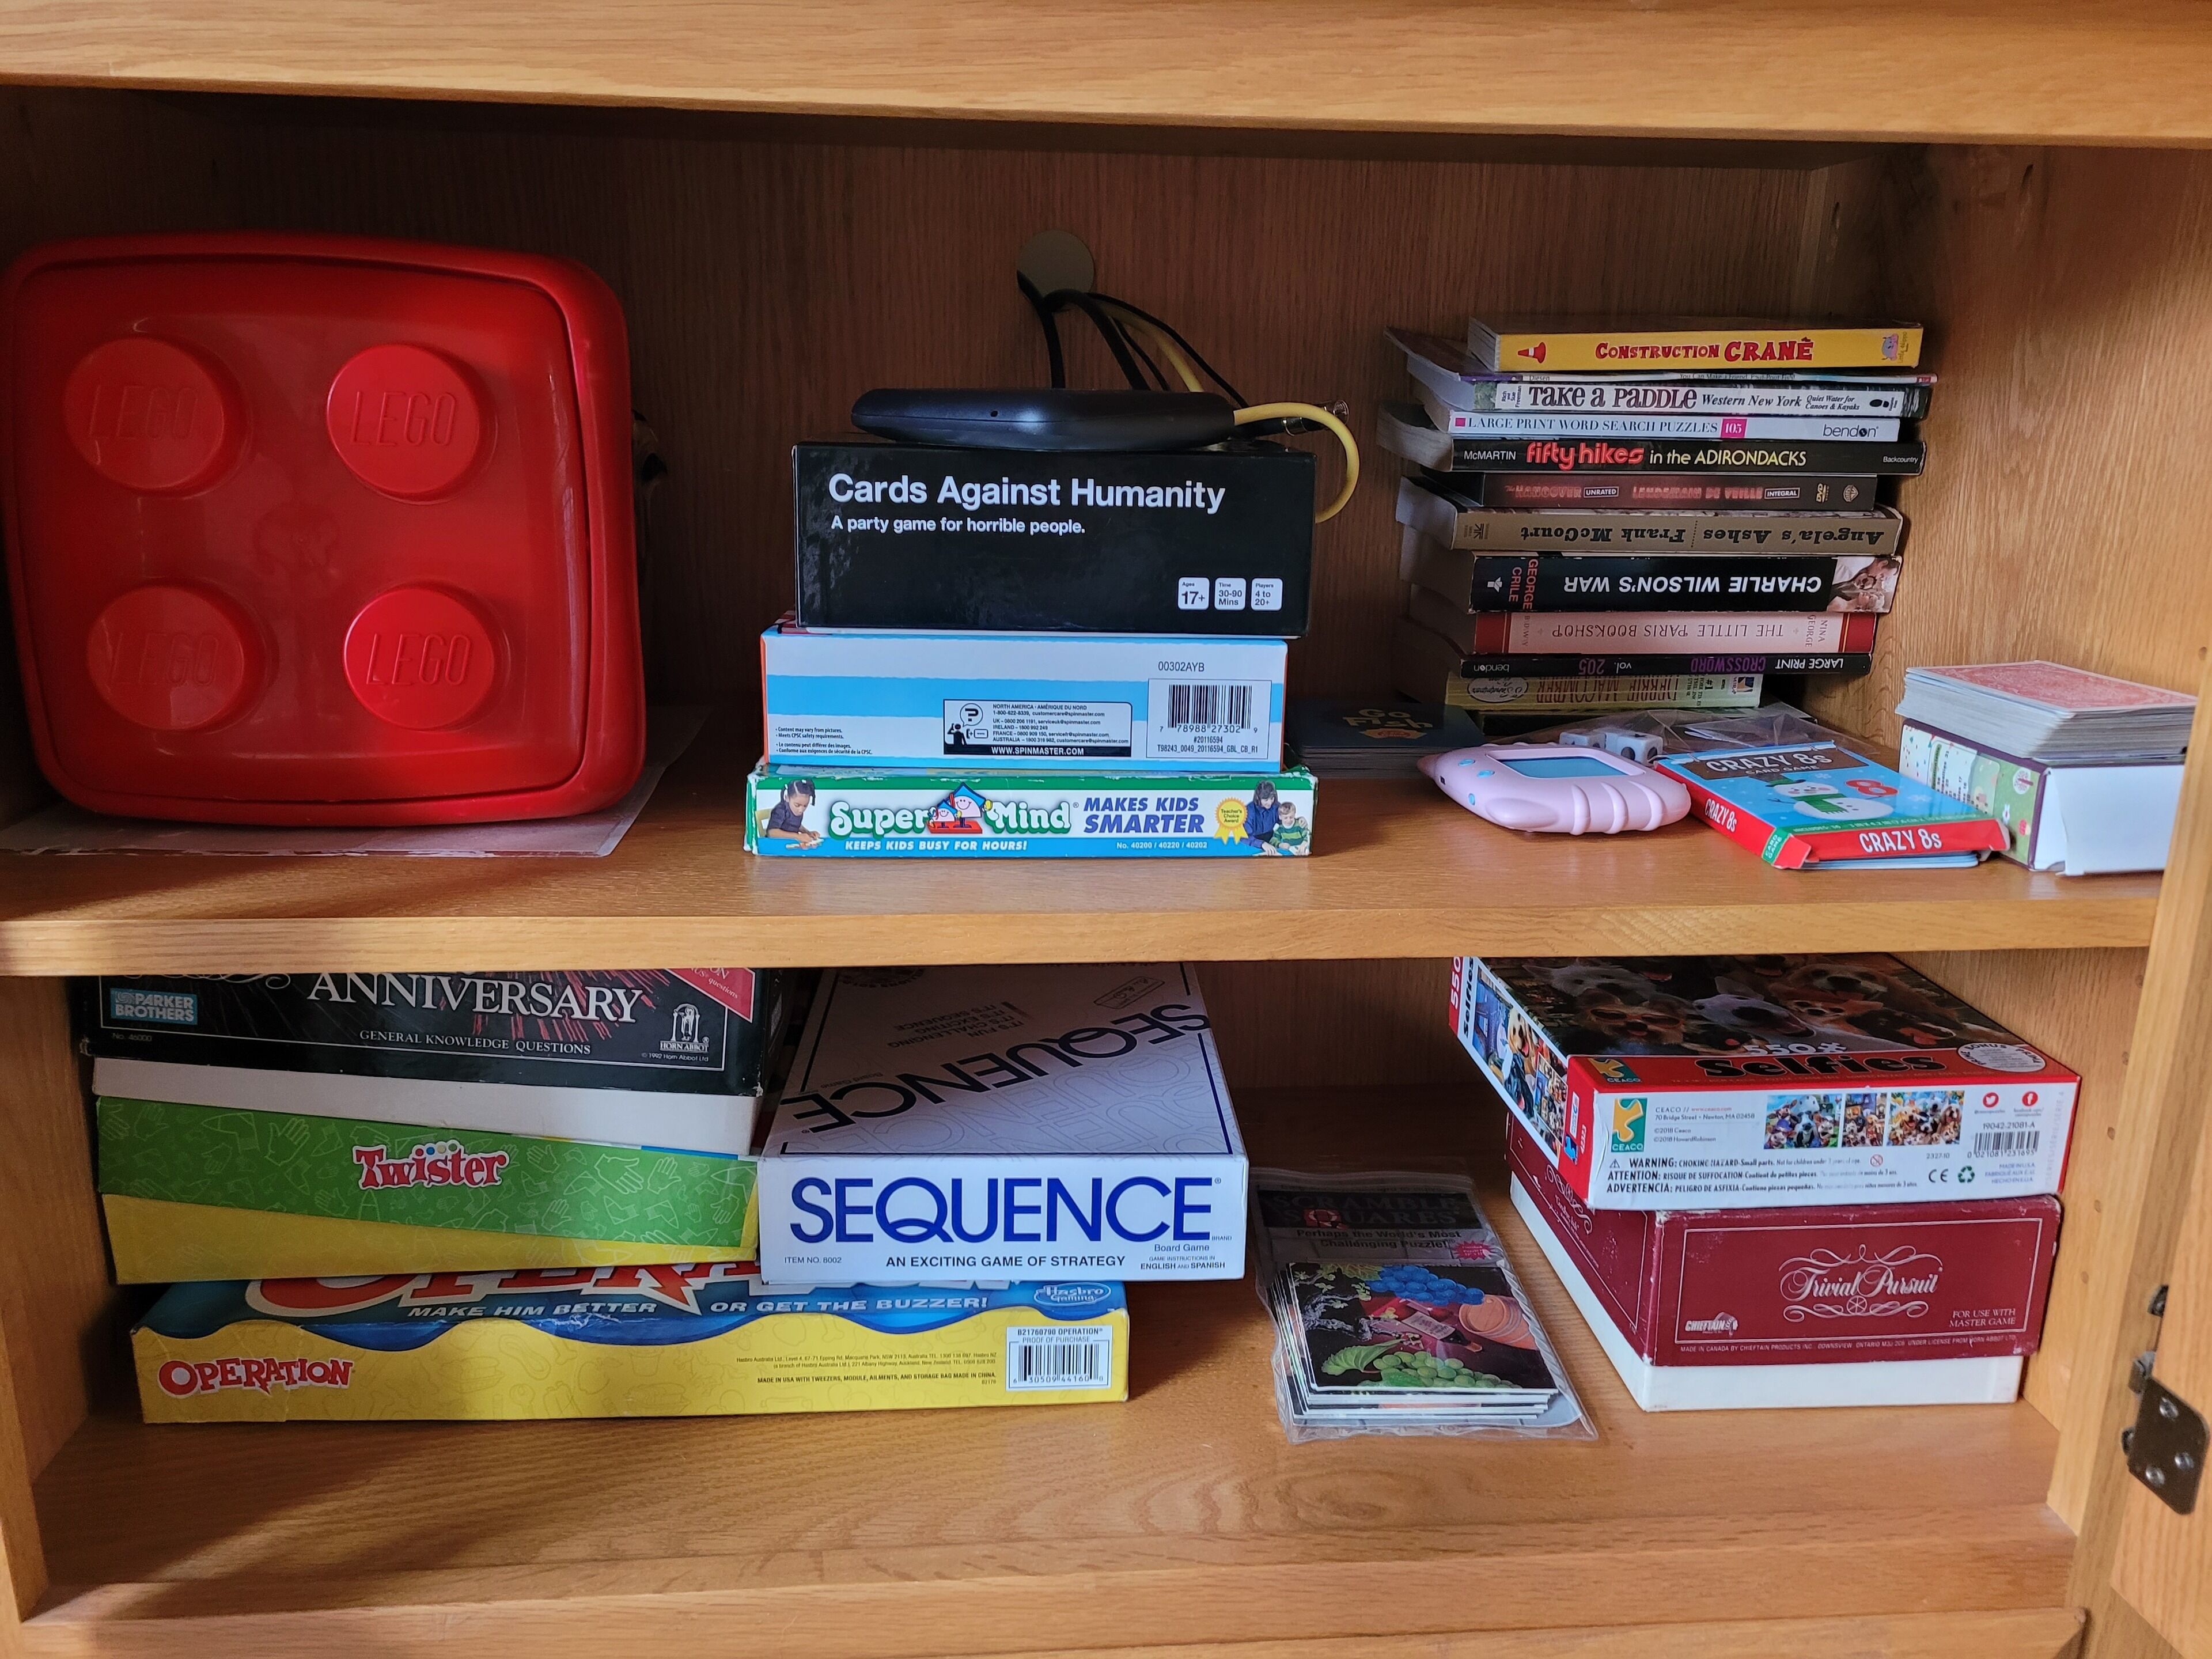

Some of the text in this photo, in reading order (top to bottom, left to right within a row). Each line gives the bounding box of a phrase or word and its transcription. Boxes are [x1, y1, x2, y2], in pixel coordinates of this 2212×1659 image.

[1595, 342, 1720, 359] CONSTRUCTION
[1590, 388, 1605, 407] a
[1702, 394, 1745, 406] Western
[1749, 395, 1773, 406] New
[1776, 396, 1802, 407] York
[1806, 395, 1824, 403] Quiet
[1844, 396, 1854, 404] for
[1837, 403, 1860, 411] Kayaks
[89, 384, 459, 448] LEGO LEGO
[1468, 418, 1742, 433] LARGE PRINT WORD SEARCH PUZZLES 105
[1823, 424, 1877, 437] bendon
[1464, 442, 1918, 471] McMARTIN fifty hikes in the ADIRONDACKS Backcountry
[828, 473, 1226, 514] Cards Against Humanity
[831, 516, 1086, 536] A party game for horrible people.
[1521, 527, 1884, 545] Angela's Ashes Frank McCourt
[1509, 567, 1522, 603] CRILE
[1523, 559, 1539, 609] GEORGE
[1564, 576, 1821, 593] CHARLIE WILSON'S WAR
[1181, 591, 1205, 604] 17+
[1552, 624, 1783, 637] THE LITTLE PARIS BOOKSHOP
[1805, 615, 1816, 647] GEORGE
[111, 633, 474, 687] LEGO LEGO
[1158, 661, 1205, 672] 00302AYB
[1474, 664, 1510, 672] bendon
[1578, 657, 1844, 675] LARGE PRINT CROSSWORD vol. 205
[1359, 709, 1411, 718] Go
[991, 747, 1084, 755] WWW.SPINMASTER.COM
[1705, 752, 1834, 773] CRAZY 8s
[1084, 798, 1199, 812] MAKES KIDS
[829, 801, 1071, 839] Super Mind
[1084, 815, 1205, 834] SMARTER
[845, 840, 1028, 850] KEEPS KIDS BUSY FOR HOURS!
[1858, 828, 1942, 854] CRAZY 8s
[135, 993, 194, 1009] PARKER
[307, 972, 643, 1024] ANNIVERSARY
[115, 1004, 194, 1022] BROTHERS
[359, 1029, 591, 1055] GENERAL KNOWLEDGE QUESTIONS
[781, 1003, 1211, 1135] SEQUENCE
[1695, 1054, 1947, 1078] Selfies
[1612, 1143, 1644, 1152] CEACO
[355, 1147, 507, 1188] Twister
[1629, 1157, 1677, 1168] WARNING:
[1608, 1171, 1661, 1180] ATTENTION:
[1607, 1183, 1673, 1193] ADVERTENCIA:
[790, 1176, 1213, 1243] SEQUENCE
[1297, 1230, 1461, 1239] Perhaps the World's Most
[1320, 1240, 1399, 1249] Challenging
[823, 1255, 842, 1264] 8002
[886, 1254, 1126, 1268] AN EXCITING GAME OF STRATEGY
[1044, 1286, 1103, 1297] Hasbro
[1780, 1264, 1943, 1302] Trivial Pursuit
[407, 1298, 988, 1317] MAKE HIM BETTER OR GET THE BUZZER!
[1993, 1308, 2016, 1317] WITH
[1949, 1319, 1986, 1327] MASTER
[158, 1358, 354, 1396] OPERATION
